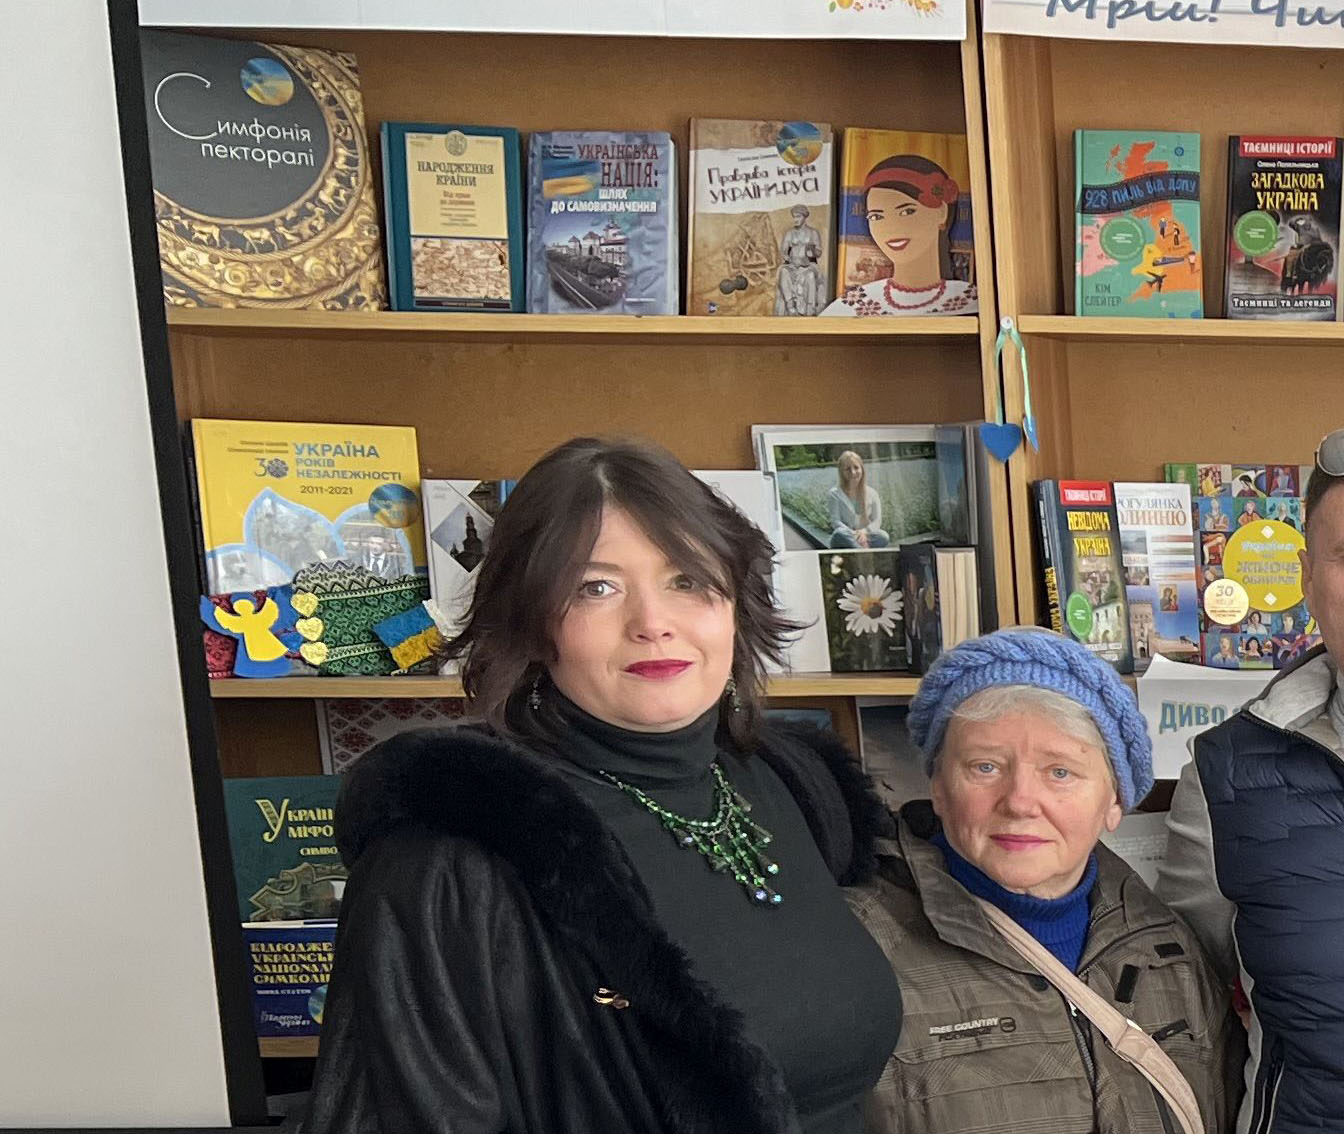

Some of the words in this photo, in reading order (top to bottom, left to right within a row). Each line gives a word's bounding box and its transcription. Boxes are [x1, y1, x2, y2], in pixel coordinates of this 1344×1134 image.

[154, 72, 311, 144] Симфонія
[201, 141, 316, 168] пекторалі
[577, 141, 659, 160] УКРАЇНСЬКА
[1243, 141, 1295, 155] ТАЄМНИЦІ
[1297, 140, 1332, 154] ІСТОРІЇ
[417, 160, 494, 175] НАРОДЖЕННЯ
[436, 174, 477, 187] КРАЇНИ
[601, 162, 658, 190] НАЦІЯ:
[707, 166, 768, 186] Правдива
[1251, 172, 1325, 190] ЗАГАДКОВА
[599, 188, 627, 199] ШЛЯХ
[1085, 189, 1108, 208] 928
[1257, 189, 1319, 211] УКРАЇНА
[551, 201, 565, 214] ДО
[567, 200, 657, 213] САМОВИЗНАЧЕННЯ
[1233, 297, 1278, 308] Таємниці
[1281, 298, 1292, 308] та
[1294, 298, 1331, 309] легенди
[294, 440, 380, 459] УКРАЇНА
[296, 458, 335, 468] РОКІВ
[296, 469, 401, 481] НЕЗАЛЕЖНОСТІ
[300, 485, 353, 495] 2011-2021
[1117, 497, 1183, 510] ОГУЛЯНКА
[1215, 585, 1234, 597] 30
[1159, 700, 1227, 734] ДИВО
[288, 825, 334, 839] МІФО
[299, 847, 338, 856] СИМВО
[250, 943, 333, 953] ВІДРОДЖЕ
